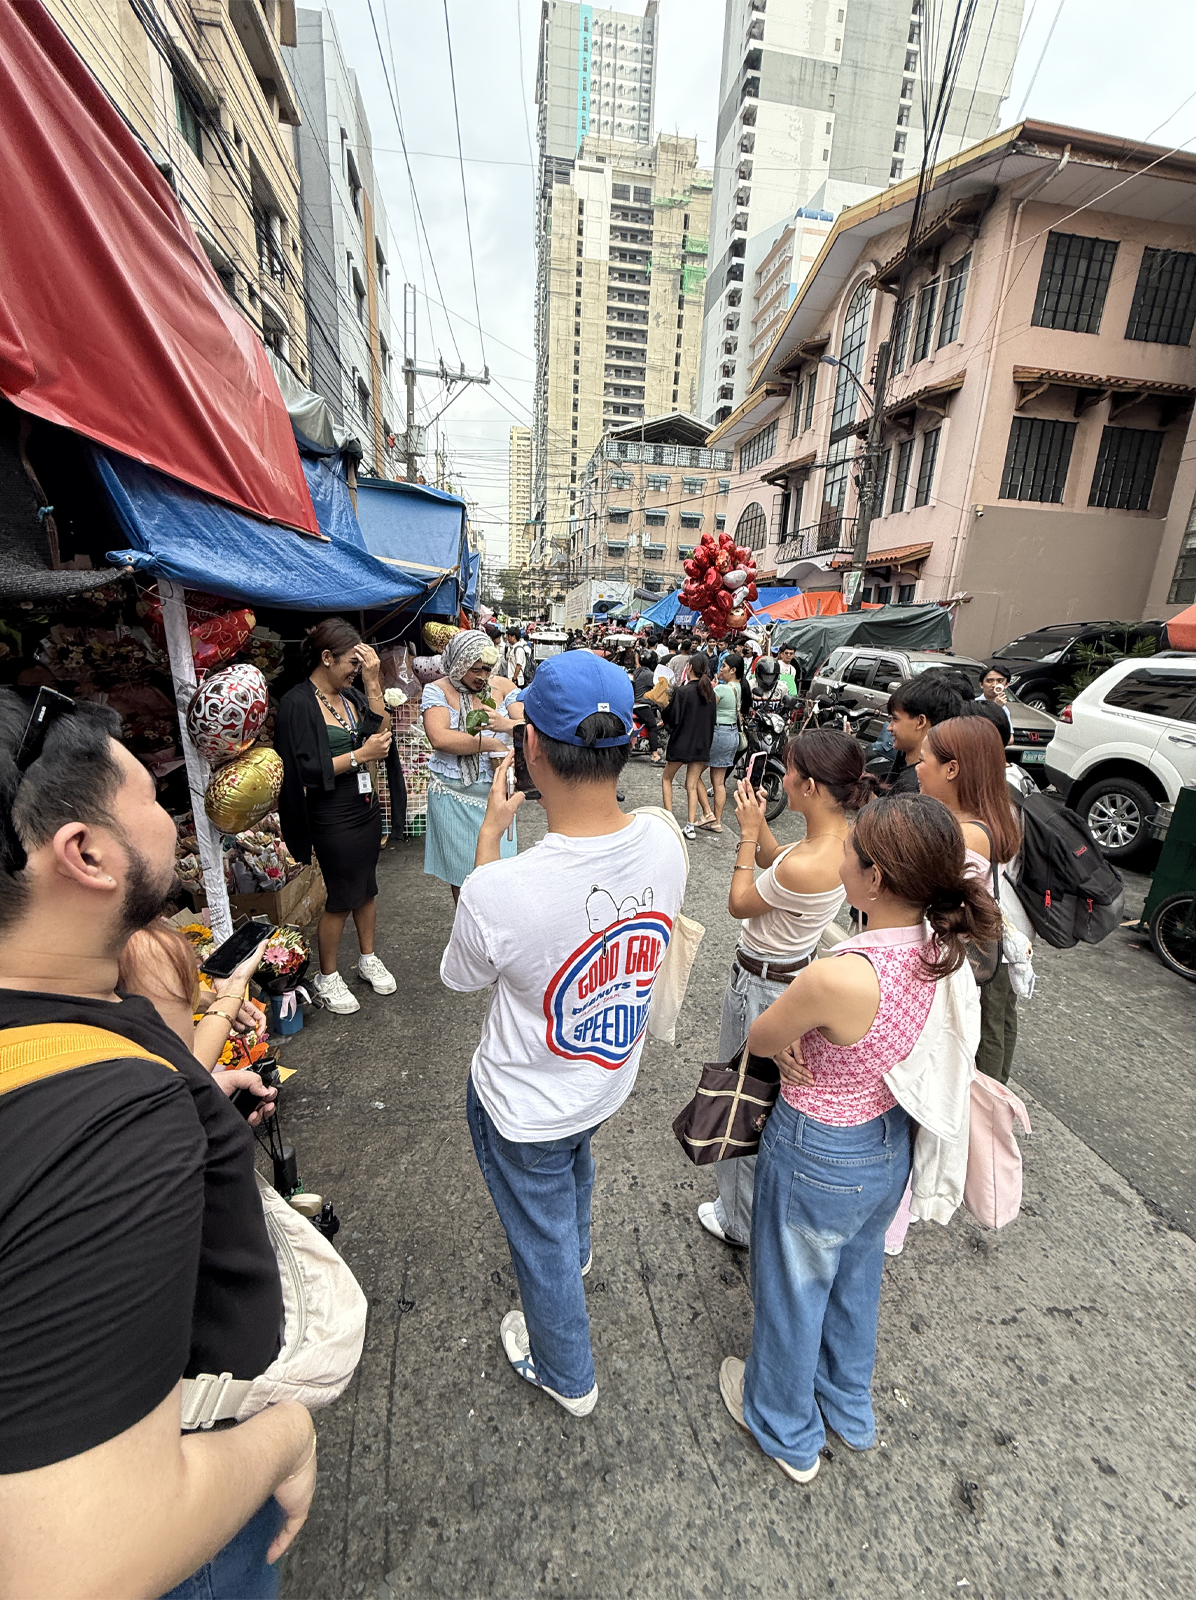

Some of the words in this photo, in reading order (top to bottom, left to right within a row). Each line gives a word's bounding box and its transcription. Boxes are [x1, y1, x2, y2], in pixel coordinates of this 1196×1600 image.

[577, 940, 620, 1000] GOOD
[624, 935, 662, 975] GRI
[571, 981, 632, 1016] PEANUTS
[573, 998, 652, 1048] SPEEDW
